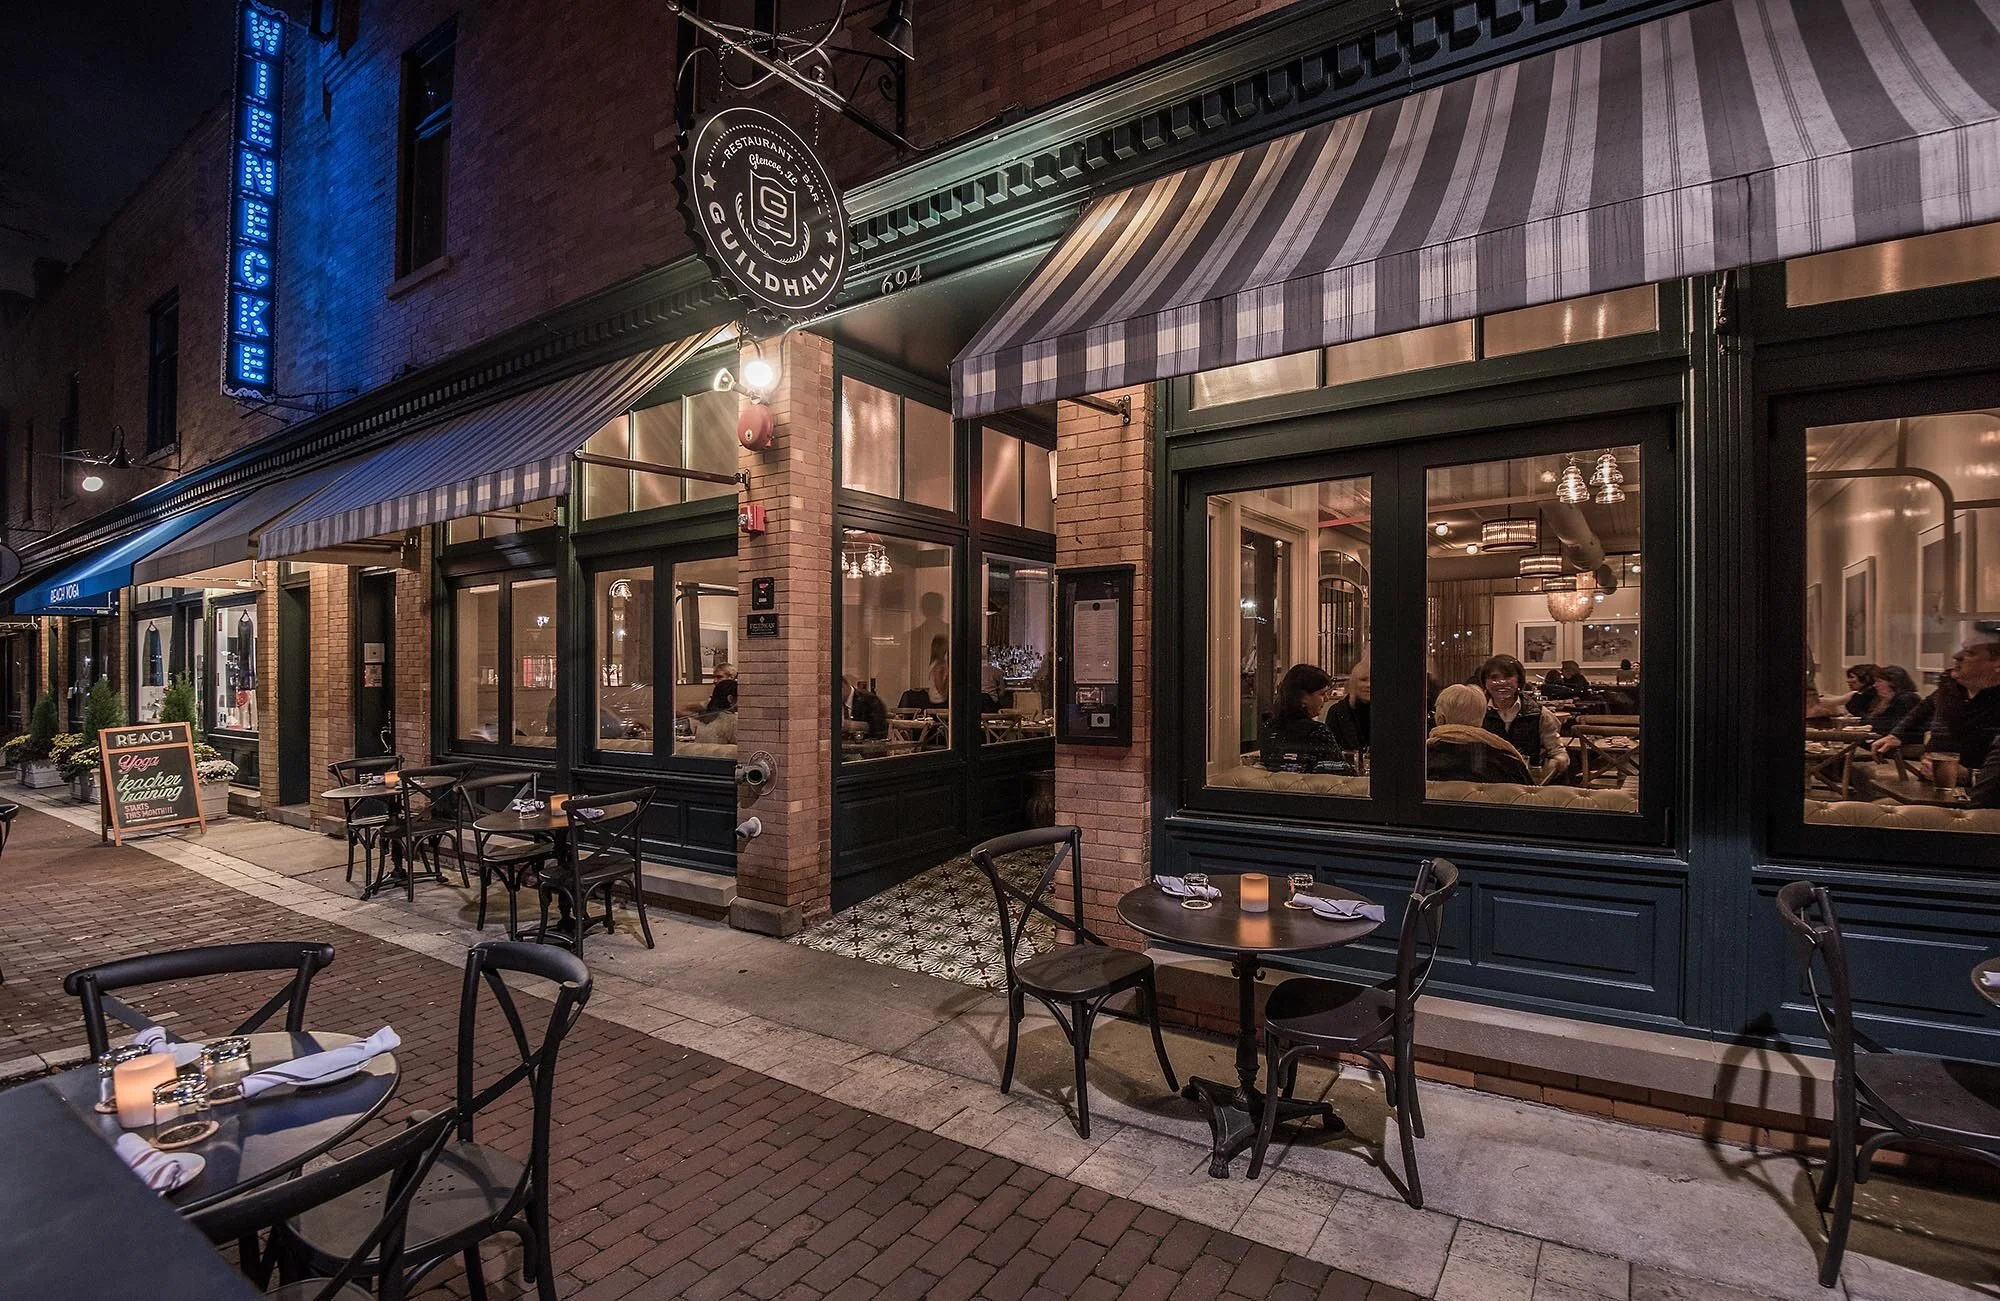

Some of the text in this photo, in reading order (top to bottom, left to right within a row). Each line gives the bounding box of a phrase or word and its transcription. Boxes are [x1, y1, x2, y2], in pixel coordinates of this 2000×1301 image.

[723, 136, 819, 202] RESTAURANT BAR
[238, 10, 282, 384] WIENECKE
[709, 201, 835, 297] GUILDHALL
[881, 264, 923, 296] 694
[50, 583, 80, 603] REACH YOGA
[116, 730, 173, 747] REACH
[118, 754, 160, 774] Yoga
[117, 772, 181, 792] teacher
[120, 786, 184, 802] training
[124, 802, 150, 812] STARTS
[124, 811, 141, 819] THIS
